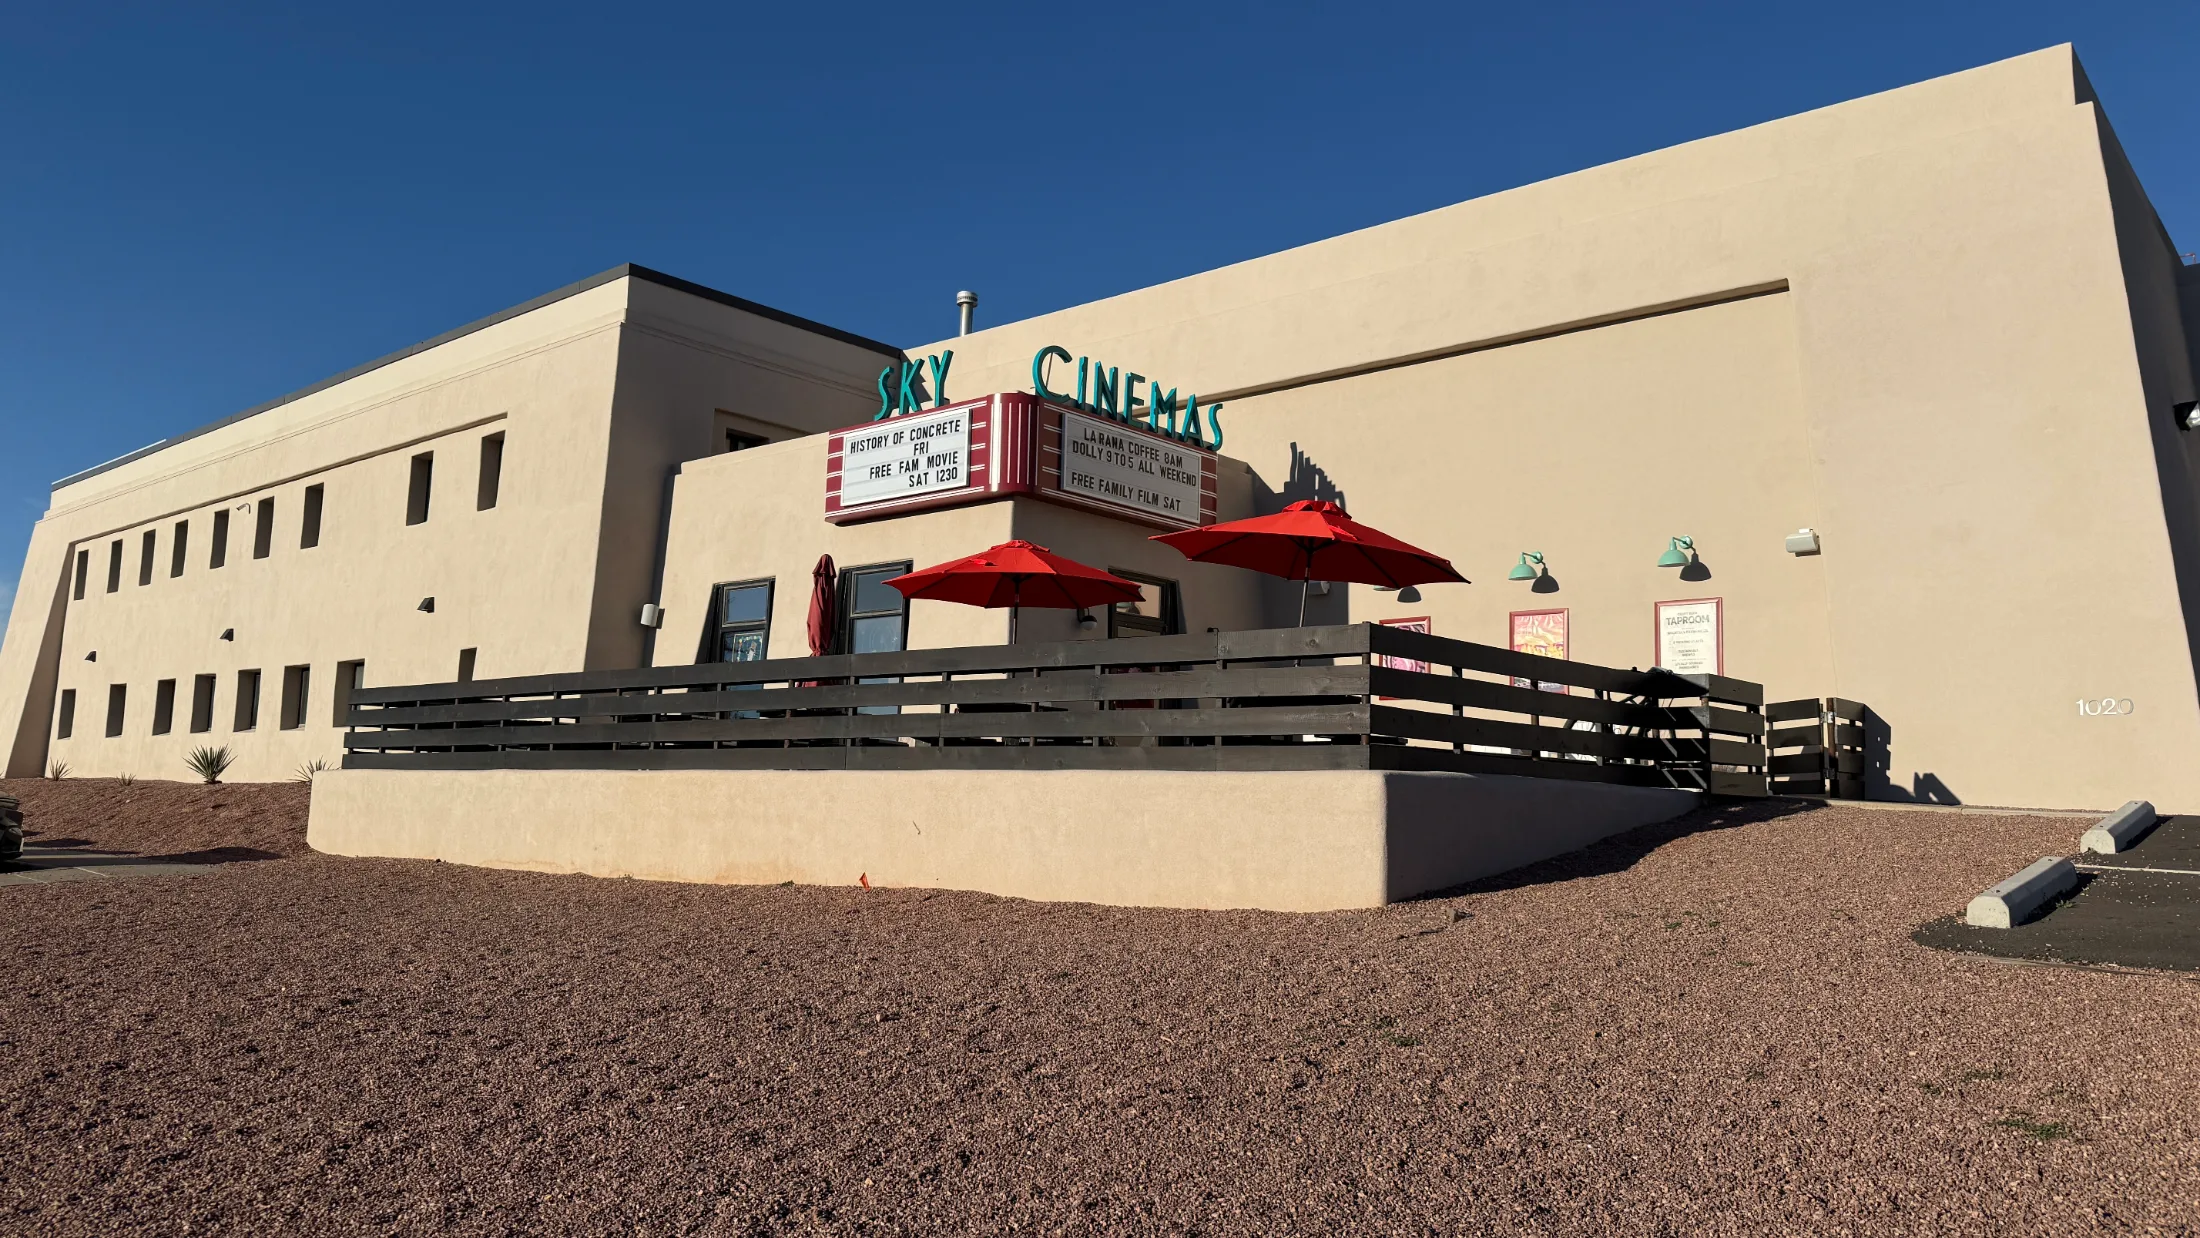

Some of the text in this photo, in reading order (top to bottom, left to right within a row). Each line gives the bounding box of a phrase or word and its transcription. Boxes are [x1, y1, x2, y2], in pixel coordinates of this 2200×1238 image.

[873, 345, 1223, 452] SKY CINEMAS
[850, 420, 960, 454] HISTORY OF CONCRETE
[914, 442, 929, 455] FRI
[870, 451, 958, 479] FREE FAM MOVIE
[1072, 440, 1103, 460] DOLLY
[1138, 460, 1154, 475] ALL
[1160, 465, 1196, 486] WEEKEND
[1128, 442, 1159, 461] COFFEE
[1164, 452, 1182, 468] 8AM
[909, 467, 958, 487] SAT 1230
[1072, 472, 1180, 511] FREE FAMILY FILM SAT
[1666, 615, 1710, 625] TAPROOM
[2076, 698, 2134, 716] 1020
